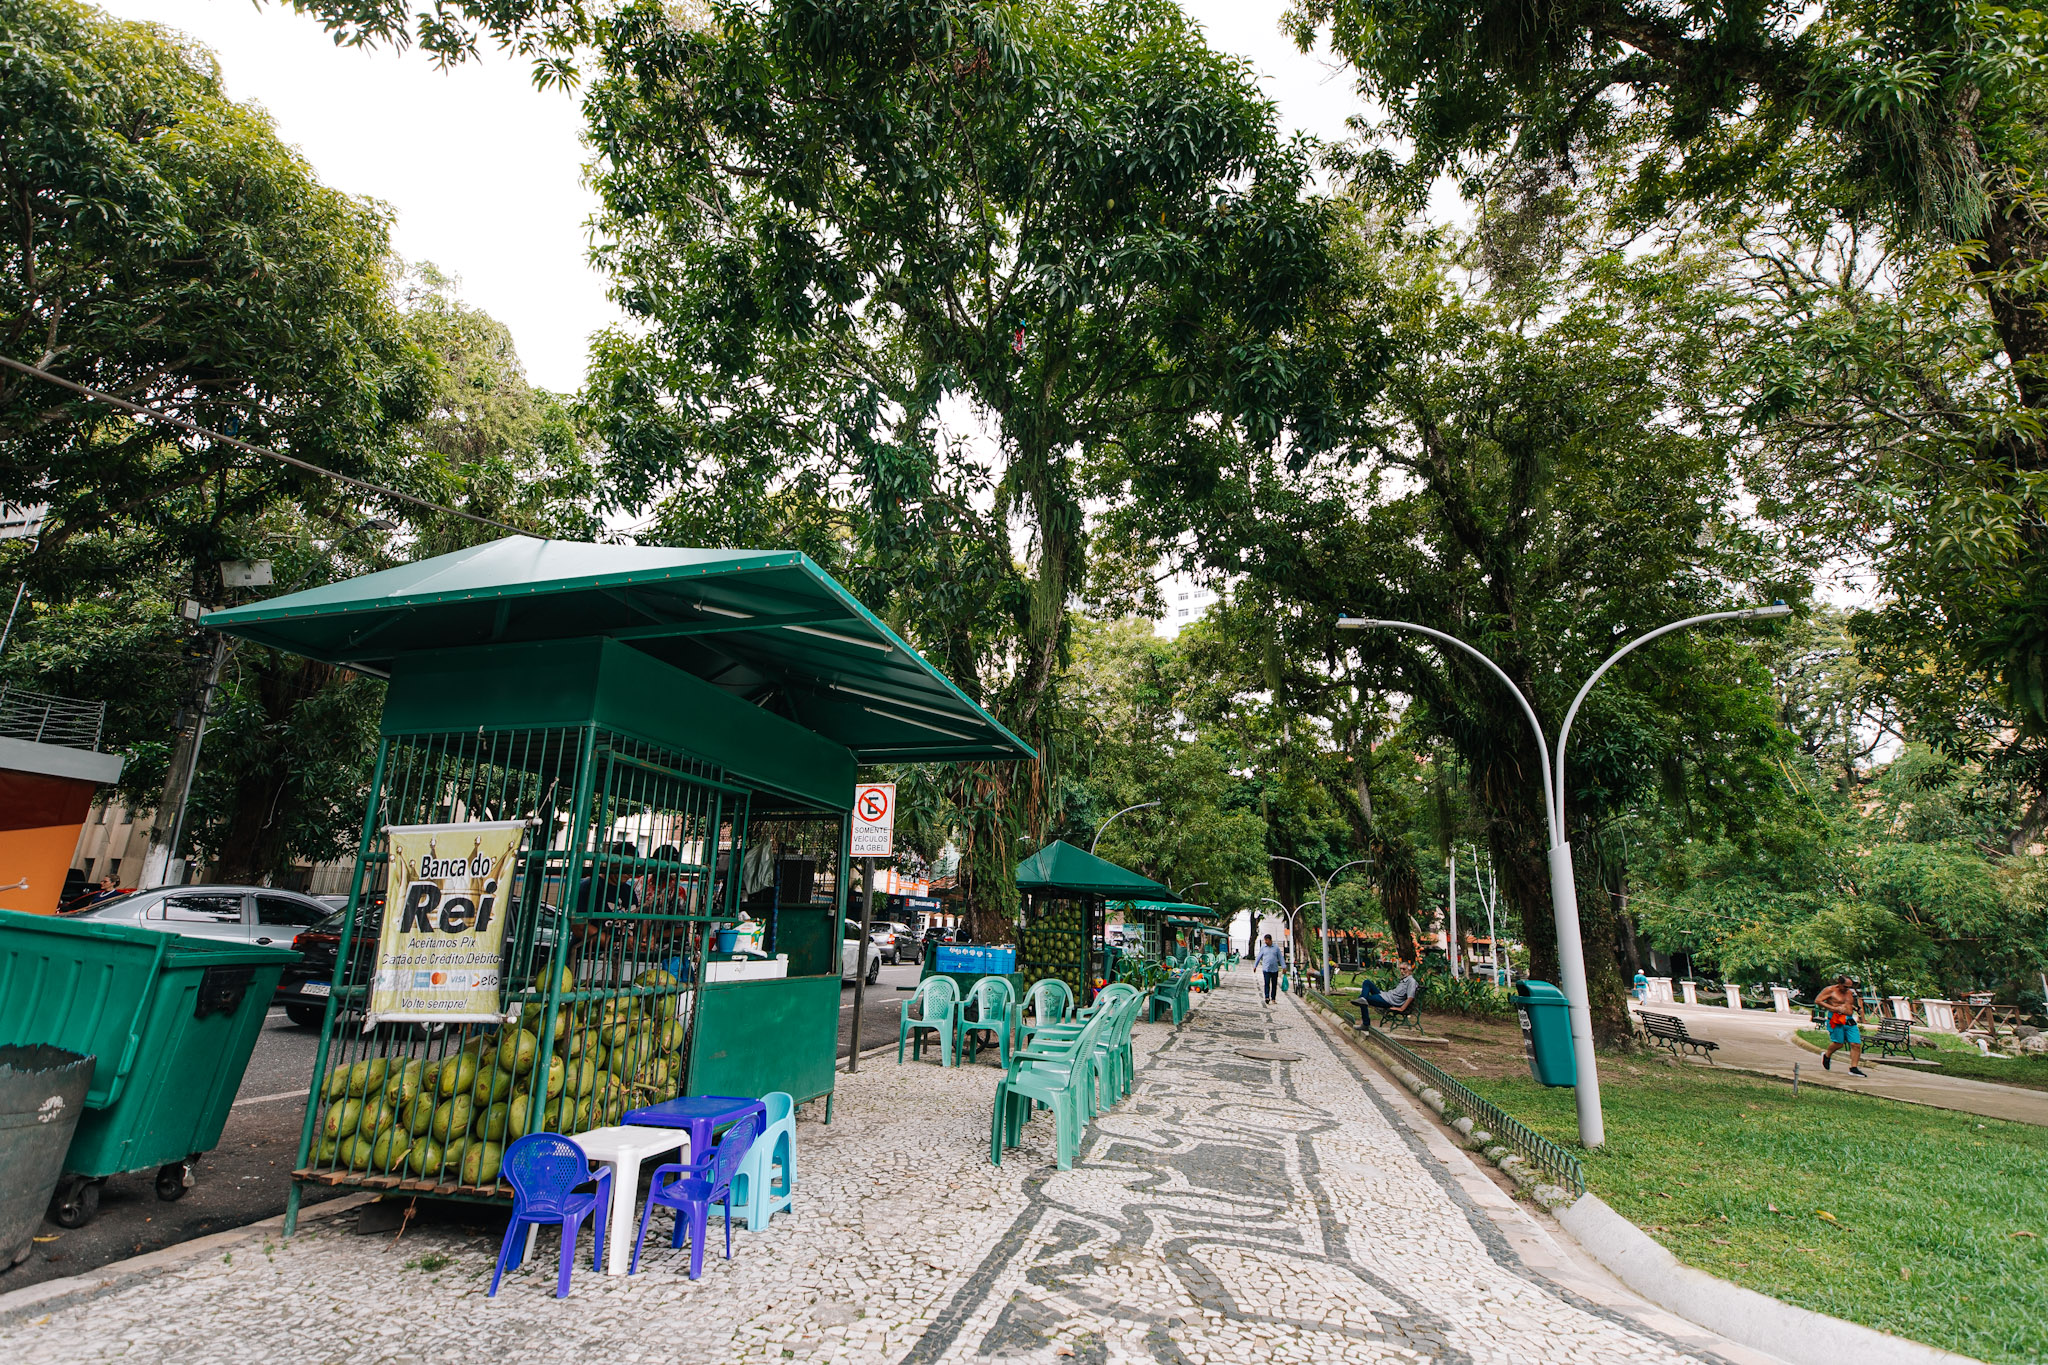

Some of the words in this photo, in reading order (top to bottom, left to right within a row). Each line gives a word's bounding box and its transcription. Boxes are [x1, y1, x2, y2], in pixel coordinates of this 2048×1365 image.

[867, 797, 879, 814] E
[855, 844, 865, 852] DA
[866, 843, 885, 852] GBEL
[421, 856, 465, 878] Banca
[471, 853, 491, 877] do
[400, 880, 498, 934] Rei
[407, 937, 458, 949] Aceitamos
[460, 936, 476, 948] Pix
[382, 953, 413, 965] Cartão
[415, 953, 427, 965] de
[429, 951, 499, 965] Crédito/Débito
[451, 975, 466, 983] VISA
[480, 974, 499, 987] elo
[401, 997, 425, 1010] Volte
[427, 997, 468, 1011] sempre!
